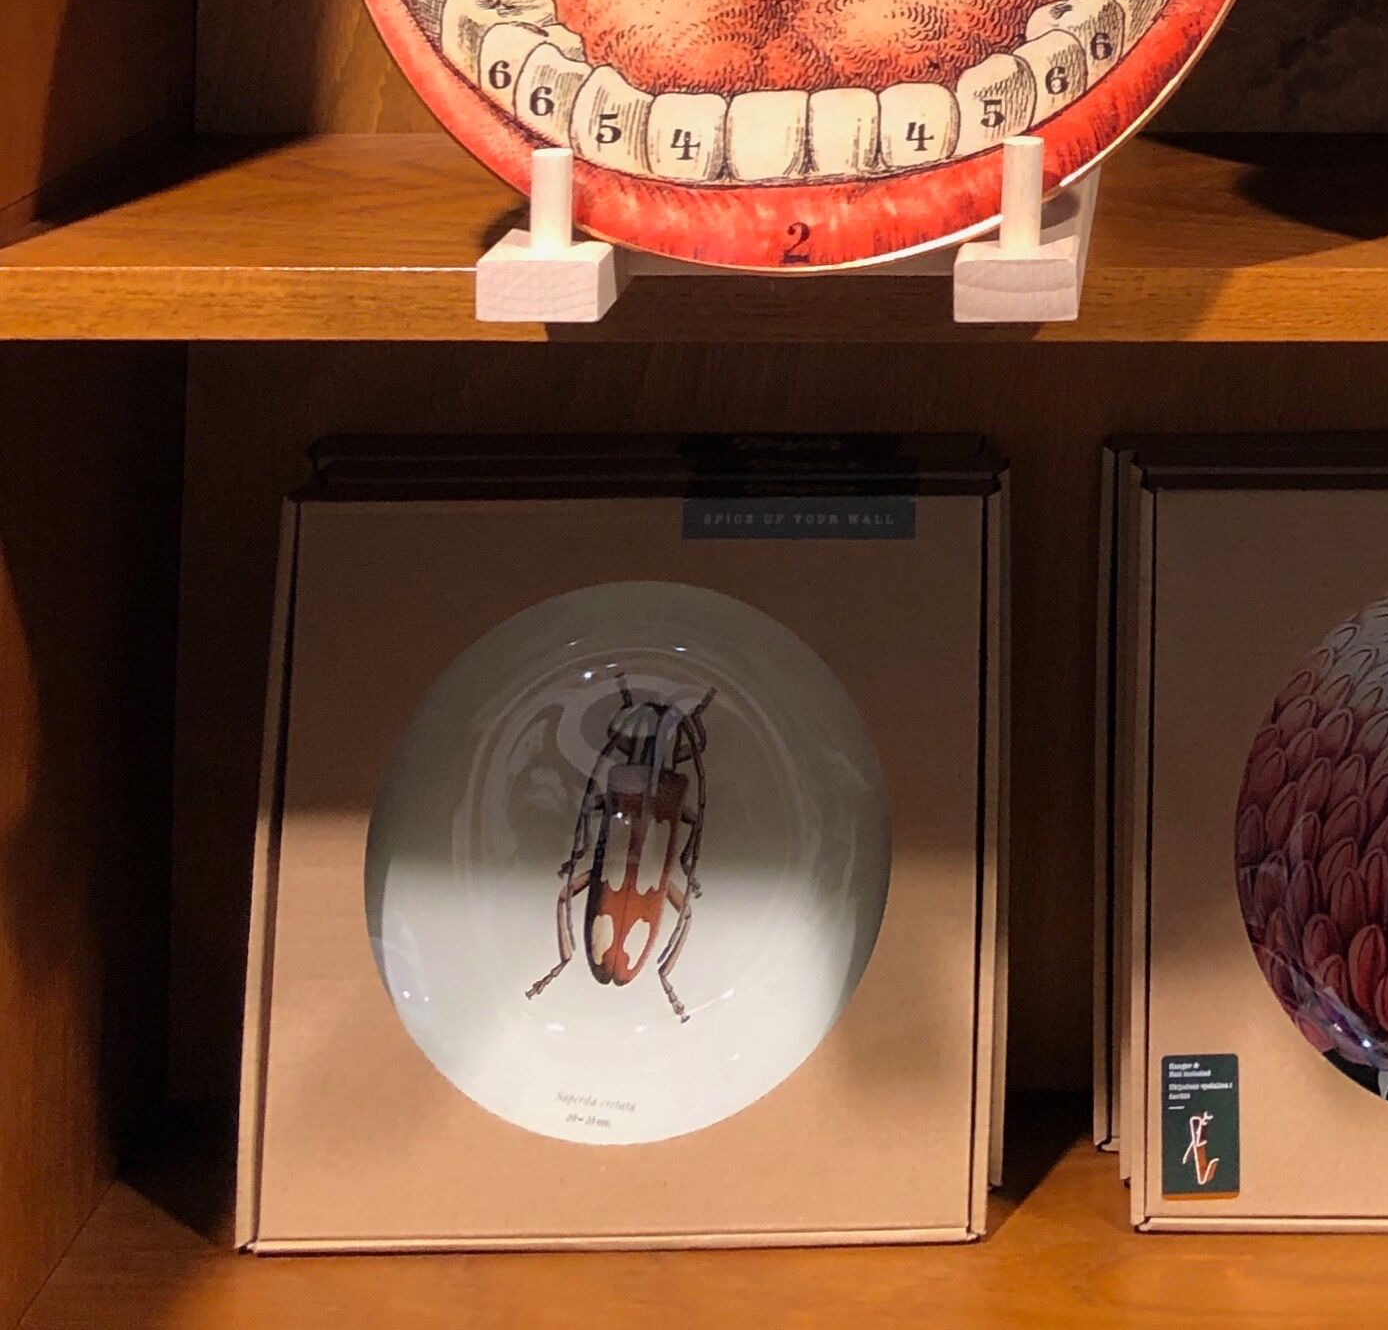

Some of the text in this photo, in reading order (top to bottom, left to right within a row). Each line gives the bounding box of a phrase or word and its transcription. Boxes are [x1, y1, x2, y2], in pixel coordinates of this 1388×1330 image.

[1088, 31, 1113, 61] 6
[488, 60, 512, 90] 6
[1044, 66, 1069, 96] 6
[529, 86, 555, 117] 6
[980, 98, 1005, 128] 5
[595, 112, 622, 144] 5
[905, 121, 935, 152] 4
[669, 127, 701, 161] 4
[780, 221, 813, 264] 2
[703, 513, 895, 526] SPICE UP YOUR WALL
